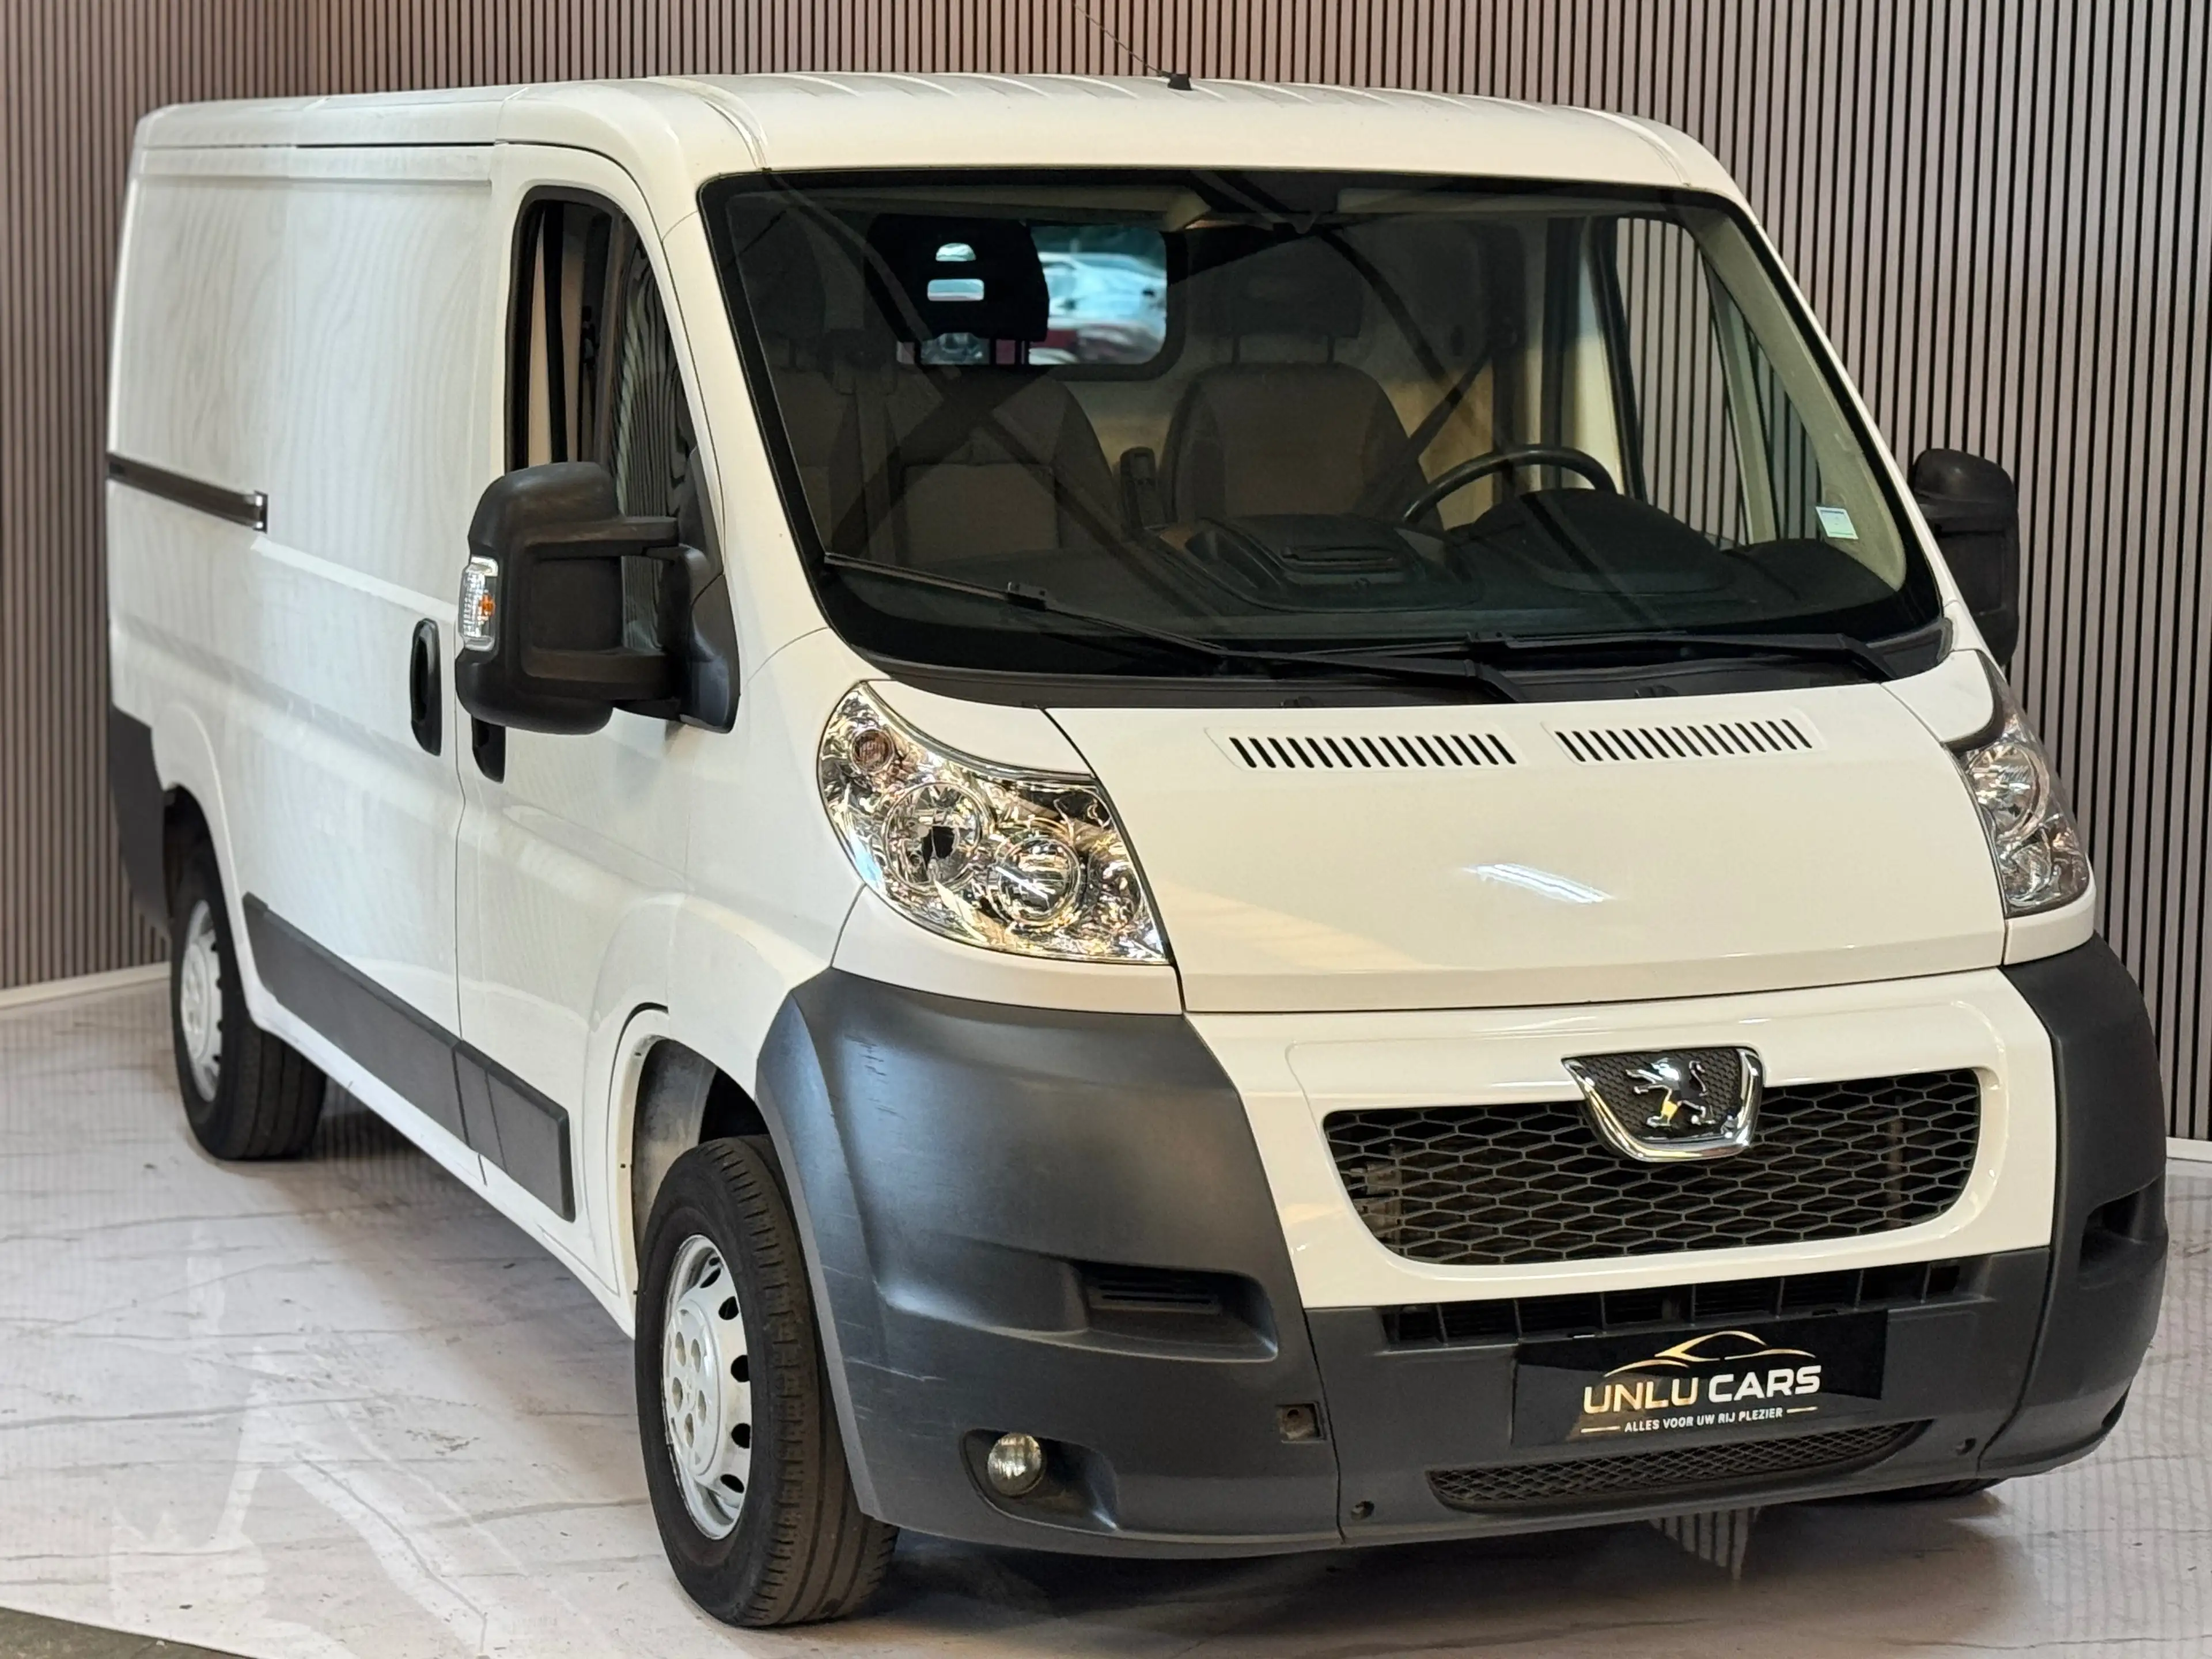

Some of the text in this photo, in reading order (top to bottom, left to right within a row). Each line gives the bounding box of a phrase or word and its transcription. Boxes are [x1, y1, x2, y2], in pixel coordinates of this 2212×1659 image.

[1584, 1365, 1822, 1414] UNLU CARS
[1624, 1407, 1783, 1433] ALLES VOOR UW RIJ PLEZIER
